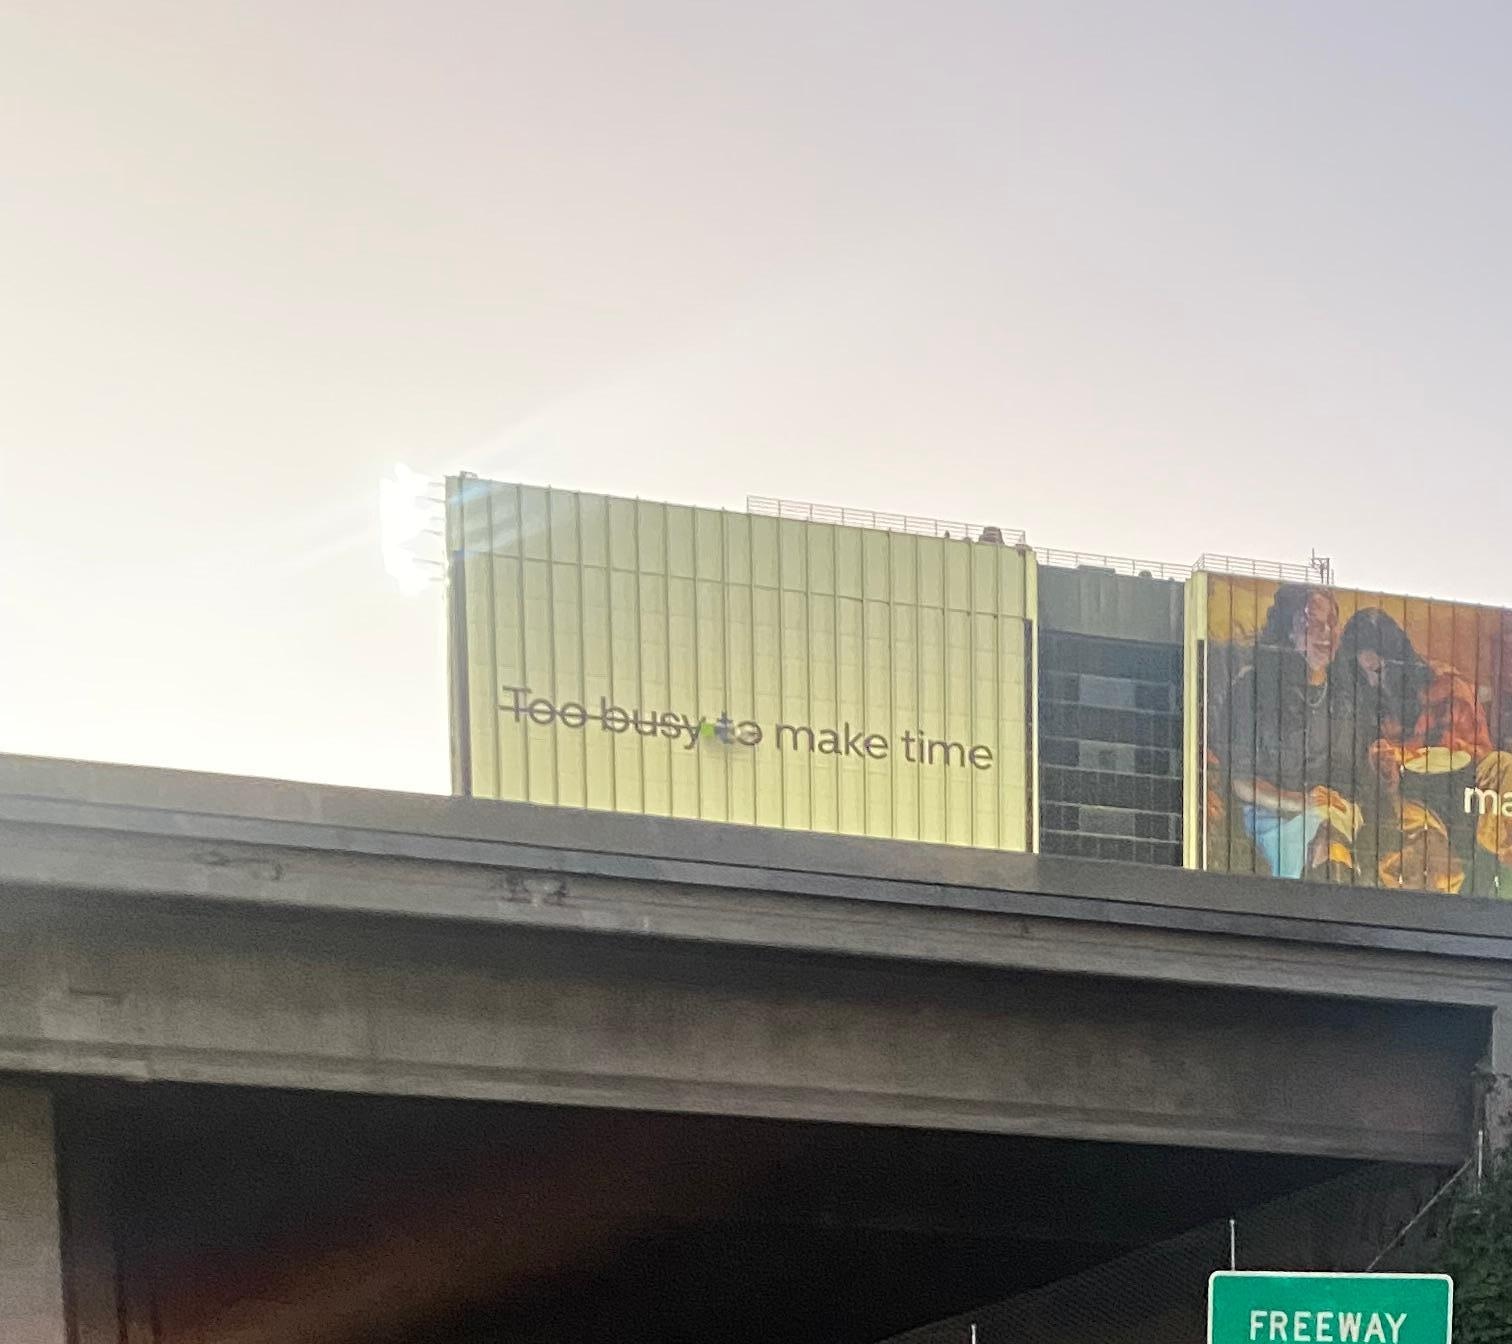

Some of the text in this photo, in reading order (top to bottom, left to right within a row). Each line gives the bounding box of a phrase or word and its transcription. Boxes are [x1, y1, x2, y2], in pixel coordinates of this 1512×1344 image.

[502, 685, 587, 728] Too
[601, 696, 706, 749] busy
[775, 721, 888, 760] make
[901, 728, 993, 770] time
[1250, 1310, 1408, 1344] FREEWAY
